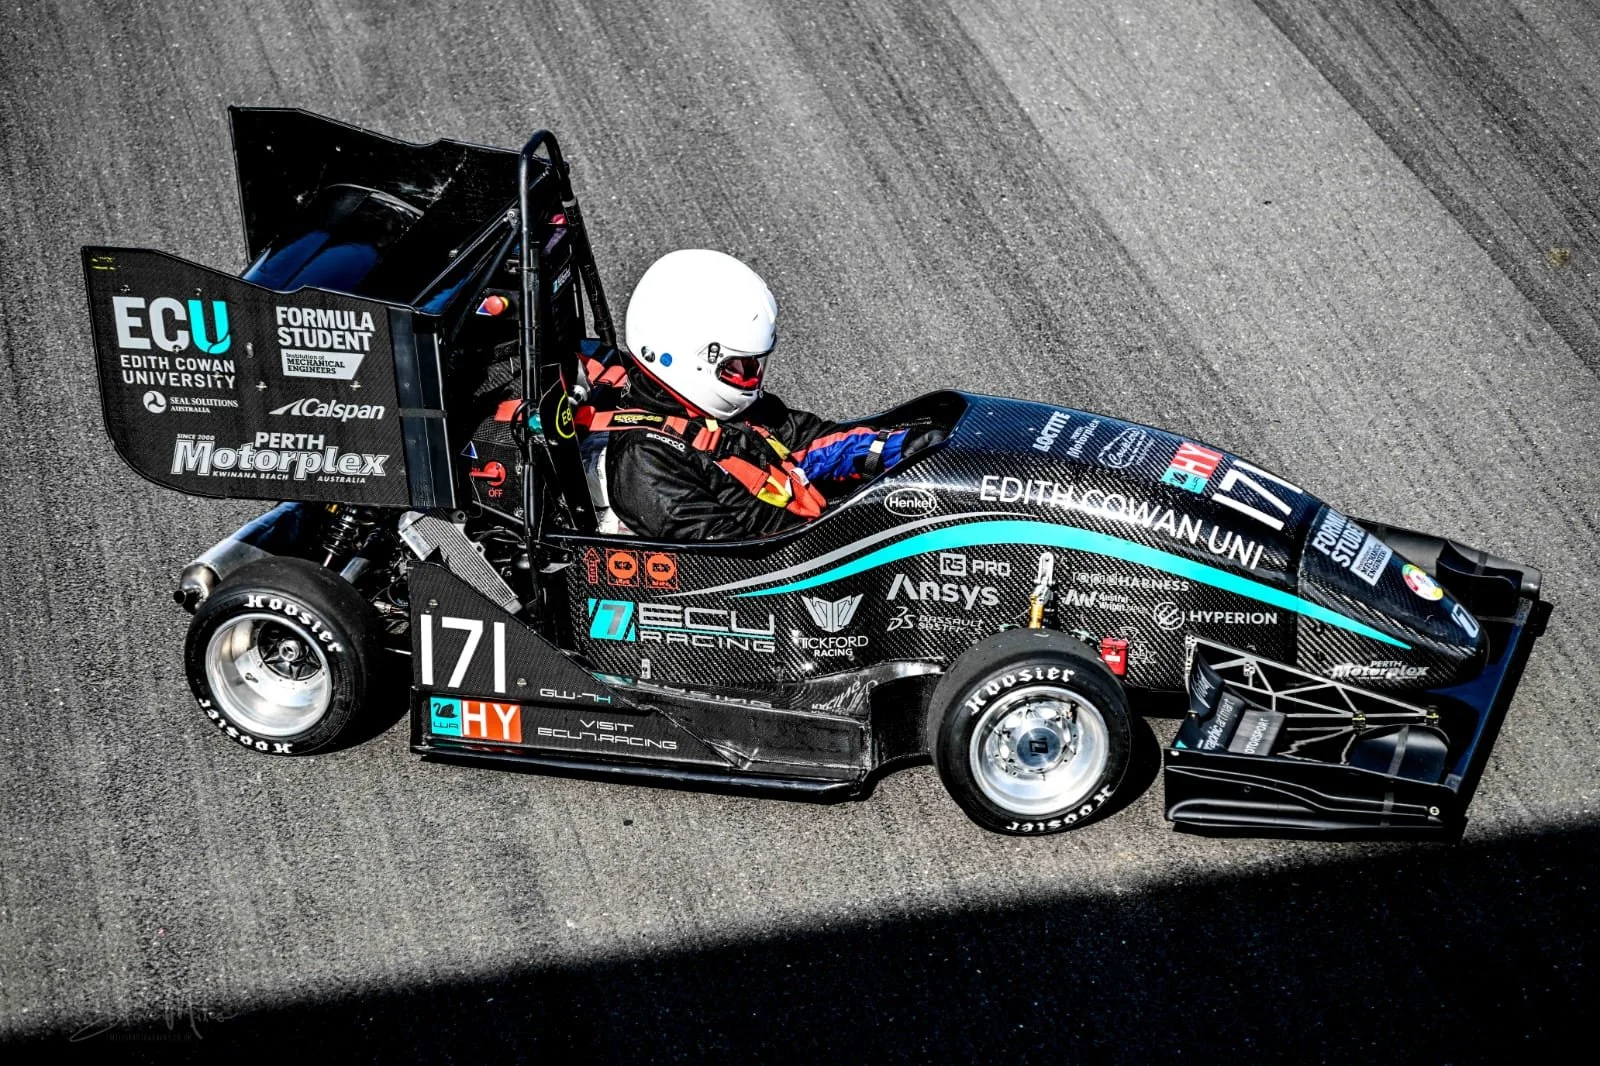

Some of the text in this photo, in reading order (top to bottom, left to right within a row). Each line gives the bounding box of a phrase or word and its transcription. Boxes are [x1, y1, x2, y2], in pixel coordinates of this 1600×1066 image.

[112, 296, 231, 355] ECU
[276, 306, 376, 332] FORMULA
[277, 326, 373, 352] STUDENT
[120, 354, 236, 373] EDITH COWAN
[287, 358, 345, 368] MECHANICAL
[287, 365, 336, 374] ENGINEERS
[122, 370, 236, 389] UNIVERSITY
[170, 397, 239, 408] SEAL SOLUTIONS
[301, 398, 386, 422] Calspan
[255, 431, 325, 450] PERTH
[1032, 411, 1071, 452] LOCTITE
[171, 439, 391, 481] Motorplex
[1170, 441, 1222, 479] HY
[212, 470, 289, 481] KWINANA BEACH
[317, 475, 366, 484] AUSTRALIA
[488, 488, 503, 498] OFF
[889, 497, 934, 510] Henkel
[1211, 459, 1304, 532] 171
[980, 475, 1265, 571] EDITH COWAN UNI
[972, 560, 1011, 577] PRO
[886, 573, 1000, 610] Ansys
[243, 594, 344, 654] Hoosier
[638, 602, 775, 636] ECU
[1189, 609, 1278, 625] HYPERION
[420, 613, 506, 694] 171
[639, 630, 776, 654] RACING
[799, 635, 869, 649] TICKFORD
[814, 648, 853, 657] RACING
[966, 666, 1075, 716] Hoosier
[462, 700, 519, 740] HY
[579, 719, 634, 732] VISIT
[1202, 724, 1224, 751] raphic
[1244, 717, 1269, 755] OTORSPORT
